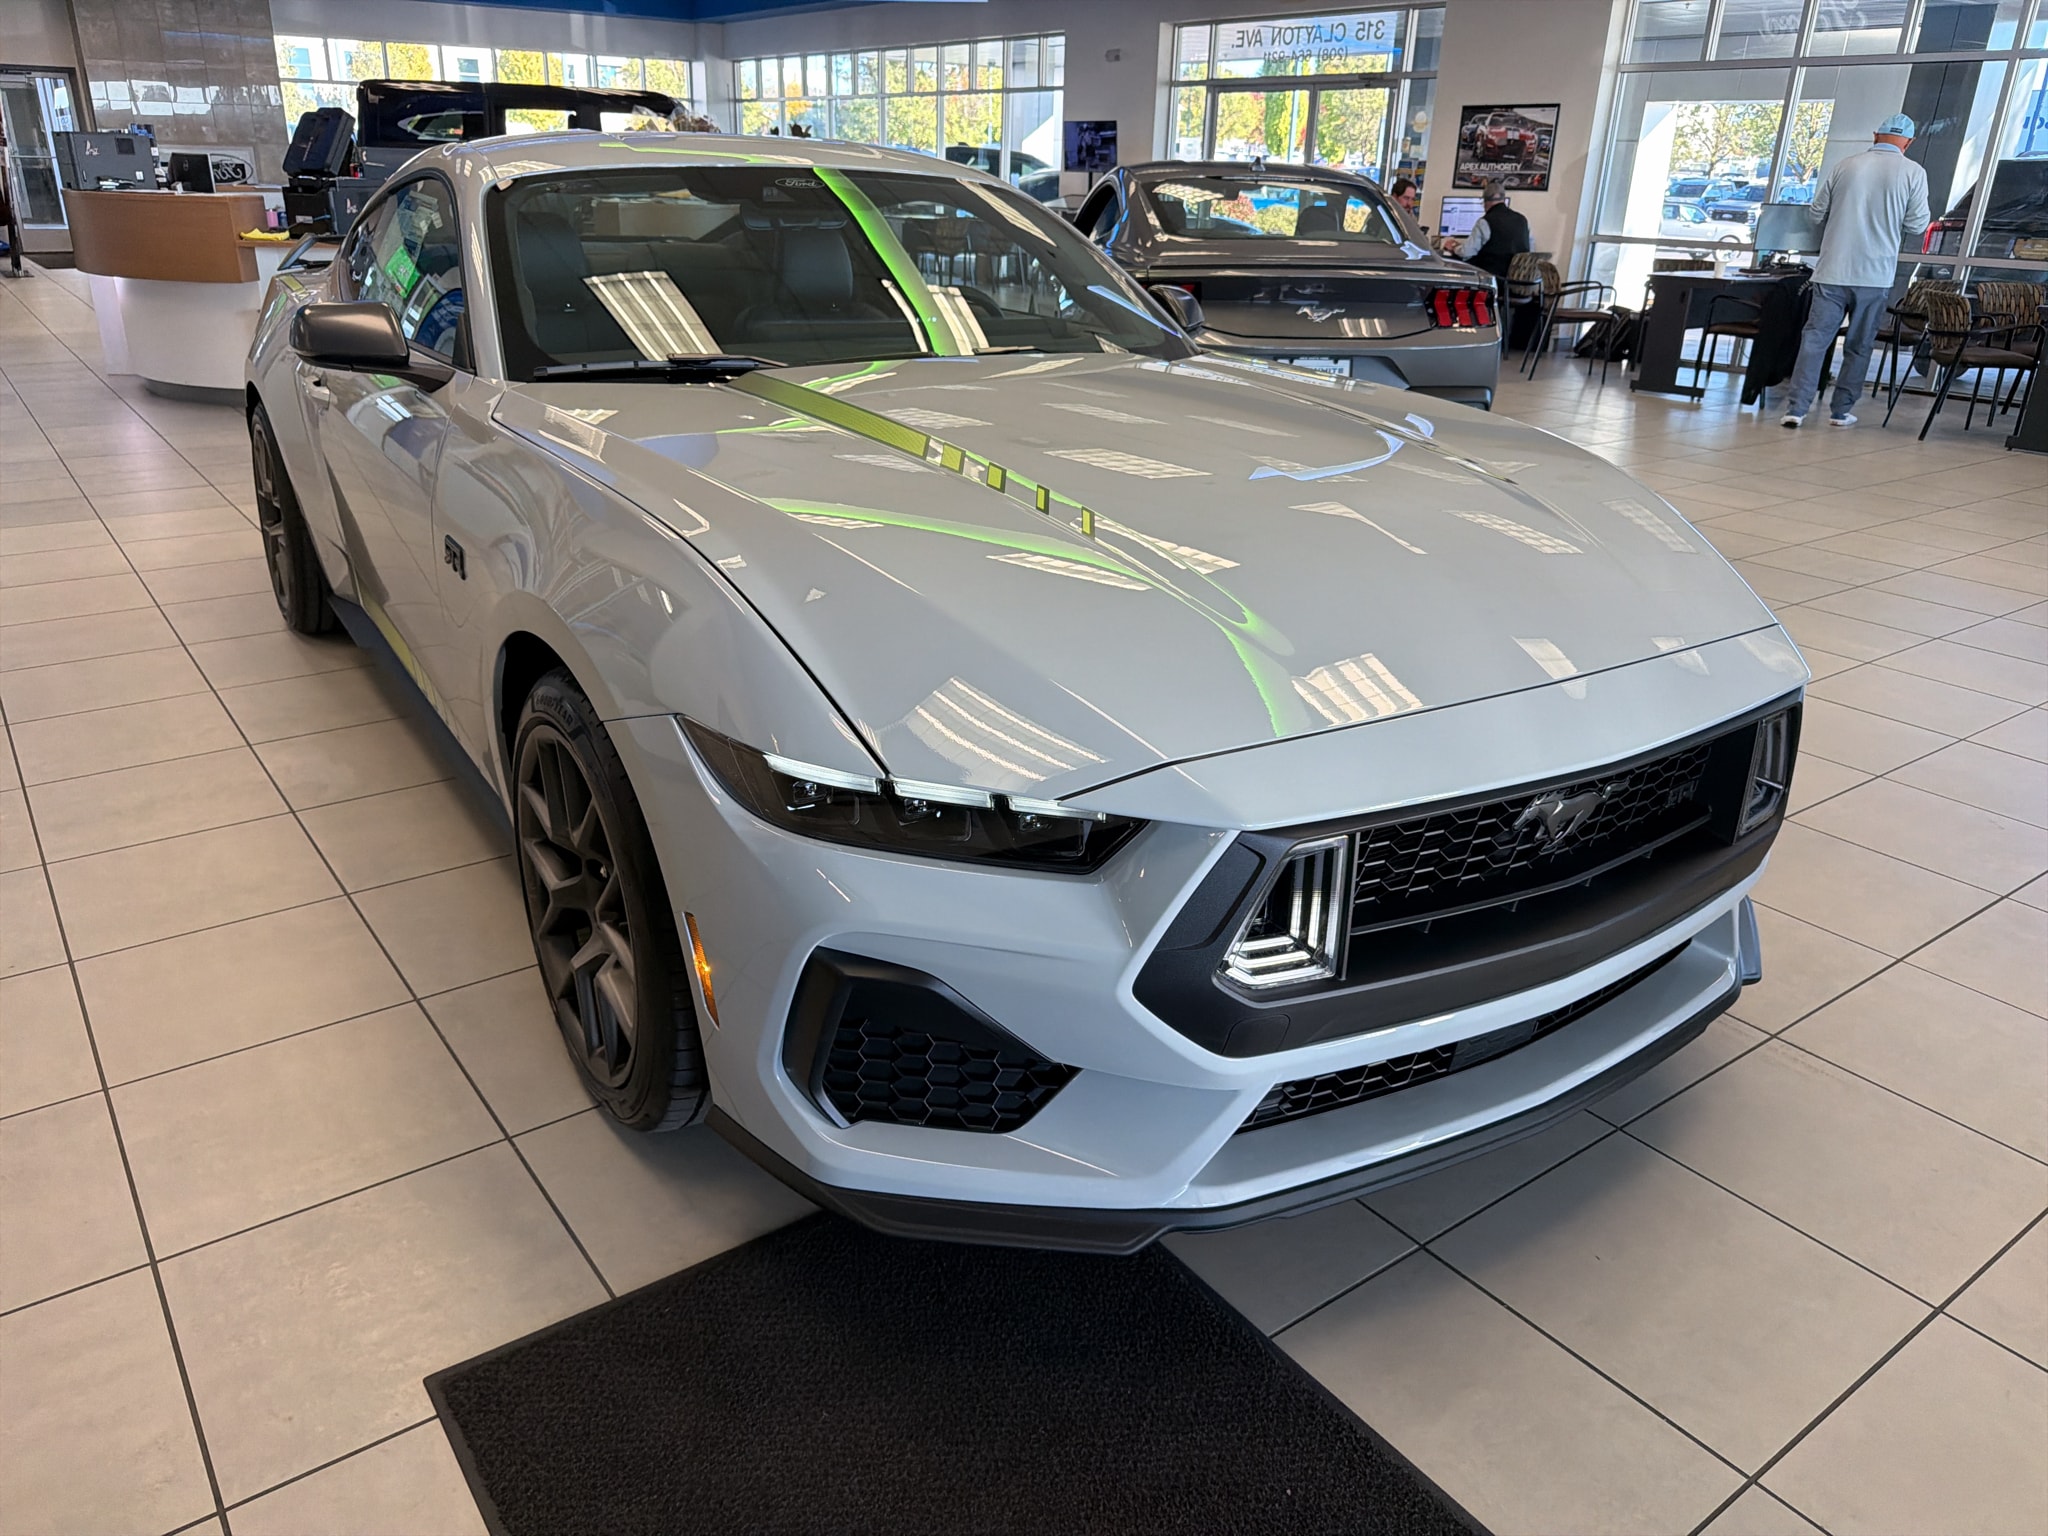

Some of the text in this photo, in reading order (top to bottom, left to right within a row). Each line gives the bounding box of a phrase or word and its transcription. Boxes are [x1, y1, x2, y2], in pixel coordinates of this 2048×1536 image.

[1460, 162, 1522, 171] APEX AUTHORITY
[785, 178, 816, 187] Ford
